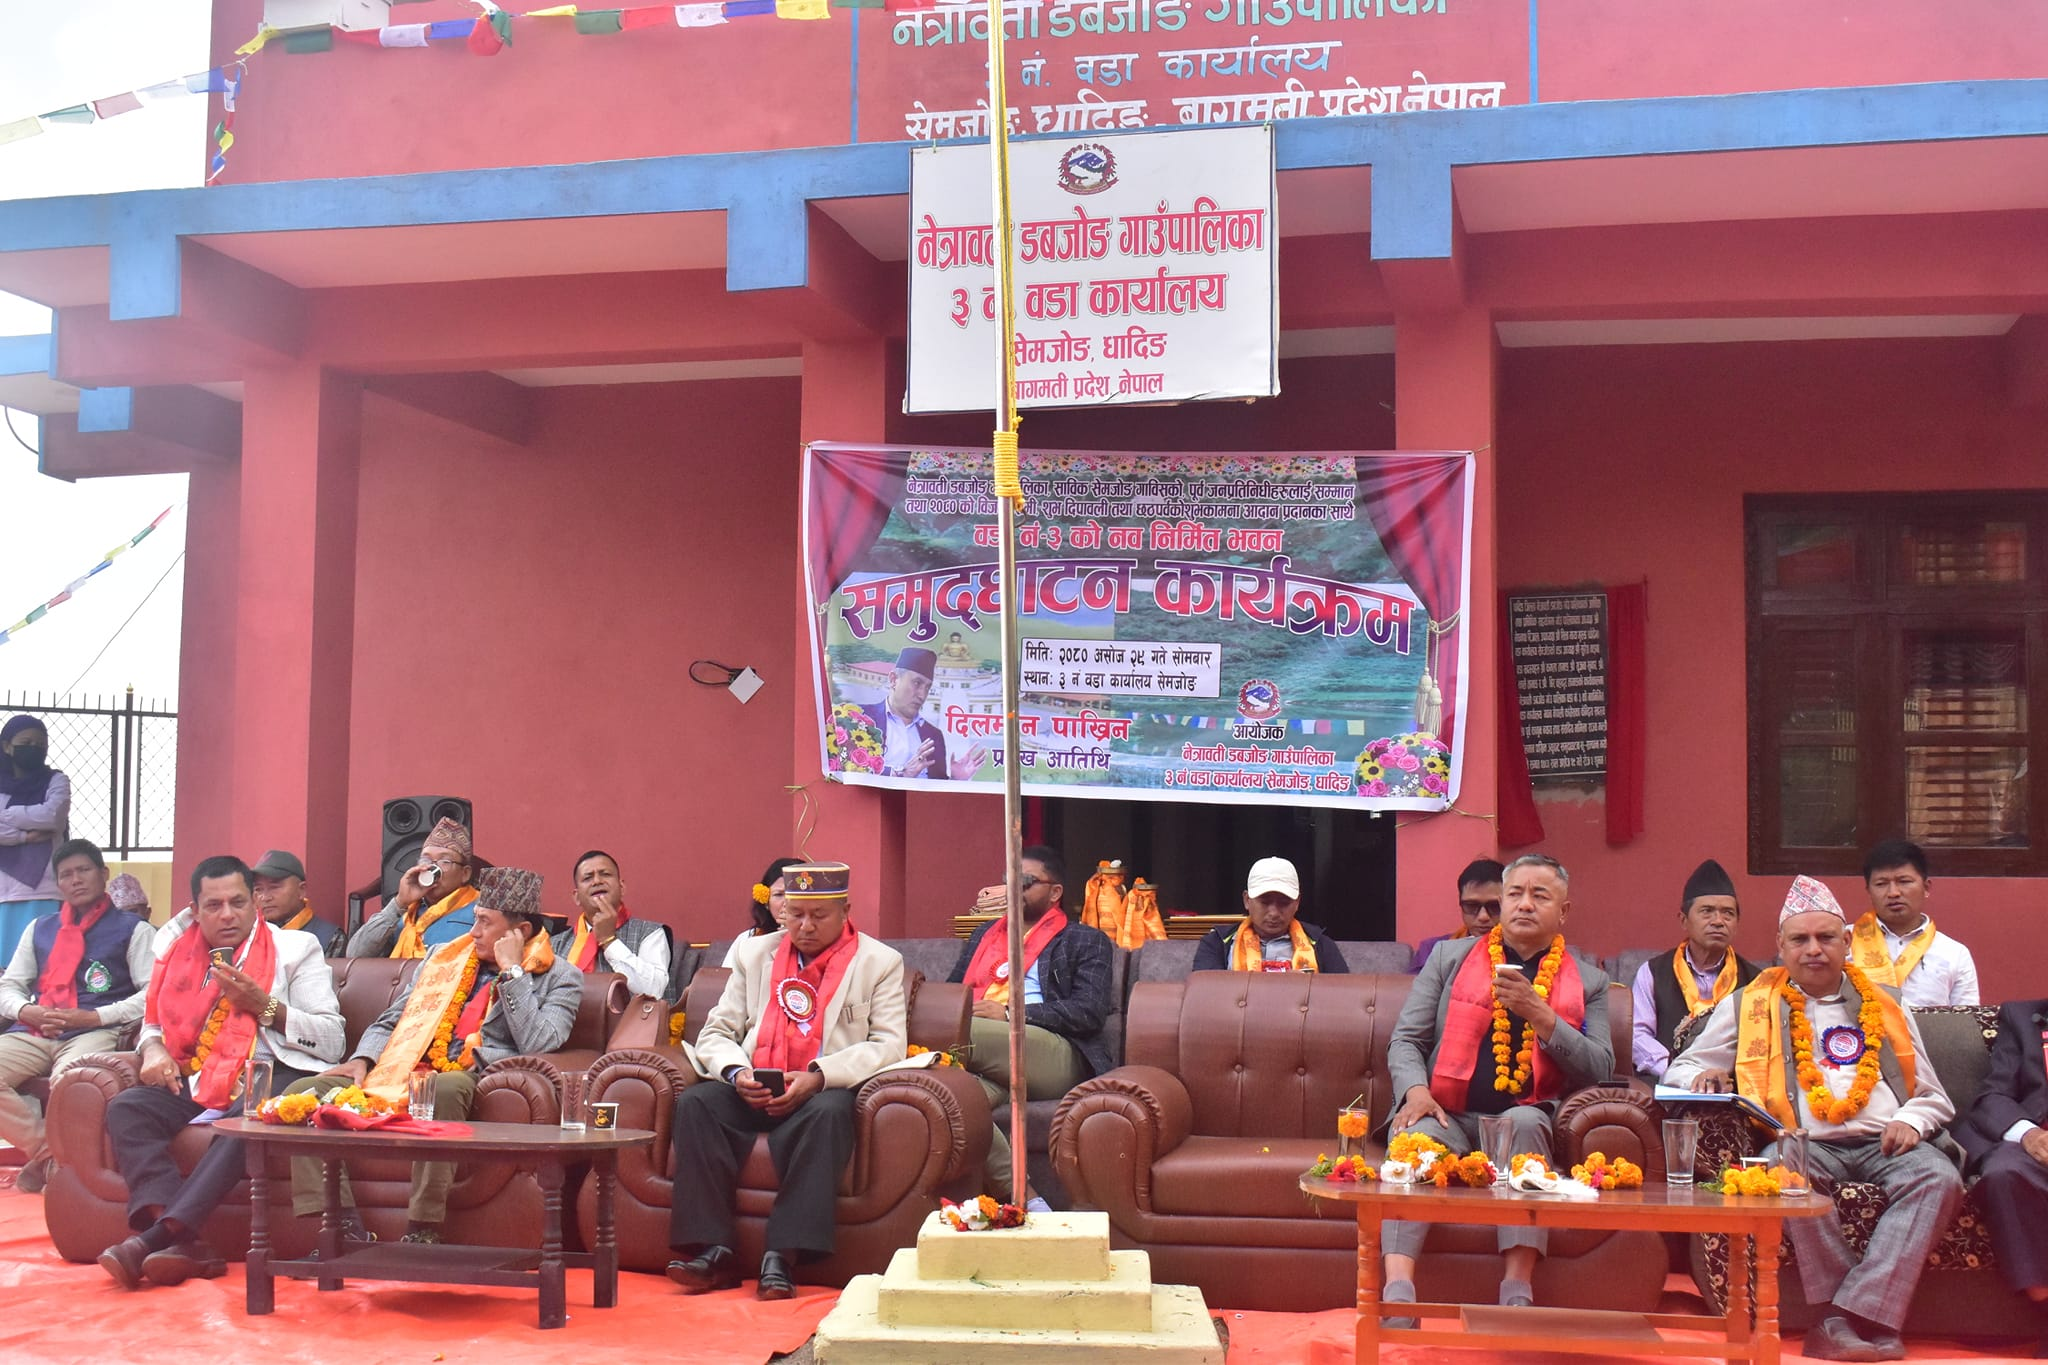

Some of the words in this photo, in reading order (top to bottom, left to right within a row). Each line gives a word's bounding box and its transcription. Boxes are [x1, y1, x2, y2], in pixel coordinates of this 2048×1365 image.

[1074, 53, 1139, 87] वडा
[1158, 36, 1343, 79] कार्यालय
[1021, 206, 1111, 262] डबजोङ
[1120, 197, 1265, 255] गाउँपालिका
[951, 288, 970, 327] ३
[1026, 281, 1080, 319] वडा
[1089, 267, 1227, 315] कार्यालय
[1103, 325, 1168, 361] धादिङ
[1118, 369, 1164, 396] नेपाल
[907, 477, 947, 496] नेत्रावती
[950, 477, 988, 496] डबजोङ
[1091, 478, 1132, 498] सेमजोङ
[1189, 480, 1204, 502] पूर्व
[1314, 484, 1355, 500] सम्मान
[906, 498, 927, 514] तथा
[960, 497, 974, 514] को
[1042, 501, 1061, 519] शुभ
[1065, 498, 1108, 517] दिपावली
[1111, 502, 1132, 517] तथा
[1243, 504, 1279, 519] आदान
[1282, 504, 1326, 521] प्रदानका
[1330, 501, 1355, 520] साथै
[1070, 520, 1102, 549] को
[1109, 527, 1143, 549] नव
[1151, 521, 1221, 551] निर्मित
[1227, 529, 1283, 551] भवन
[1153, 555, 1417, 655] कार्यक्रम
[1059, 646, 1088, 666] २०८०
[1095, 644, 1125, 666] असोज
[1130, 648, 1145, 668] २९
[1151, 644, 1168, 664] गते
[1059, 671, 1066, 690] ३
[1072, 668, 1081, 687] नं
[1085, 671, 1105, 688] वडा
[1110, 669, 1152, 690] कार्यालय
[1157, 671, 1197, 692] सेमजोङ
[1233, 722, 1284, 740] आयोजक
[1182, 742, 1225, 763] नेत्रावती
[1228, 744, 1269, 764] डबजोङ
[1272, 745, 1335, 766] गाउँपालिका
[1165, 770, 1173, 786] ३
[1176, 768, 1188, 785] नं
[1191, 770, 1211, 785] वडा
[1213, 769, 1264, 788] कार्यालय
[1316, 772, 1350, 792] धादिङ
